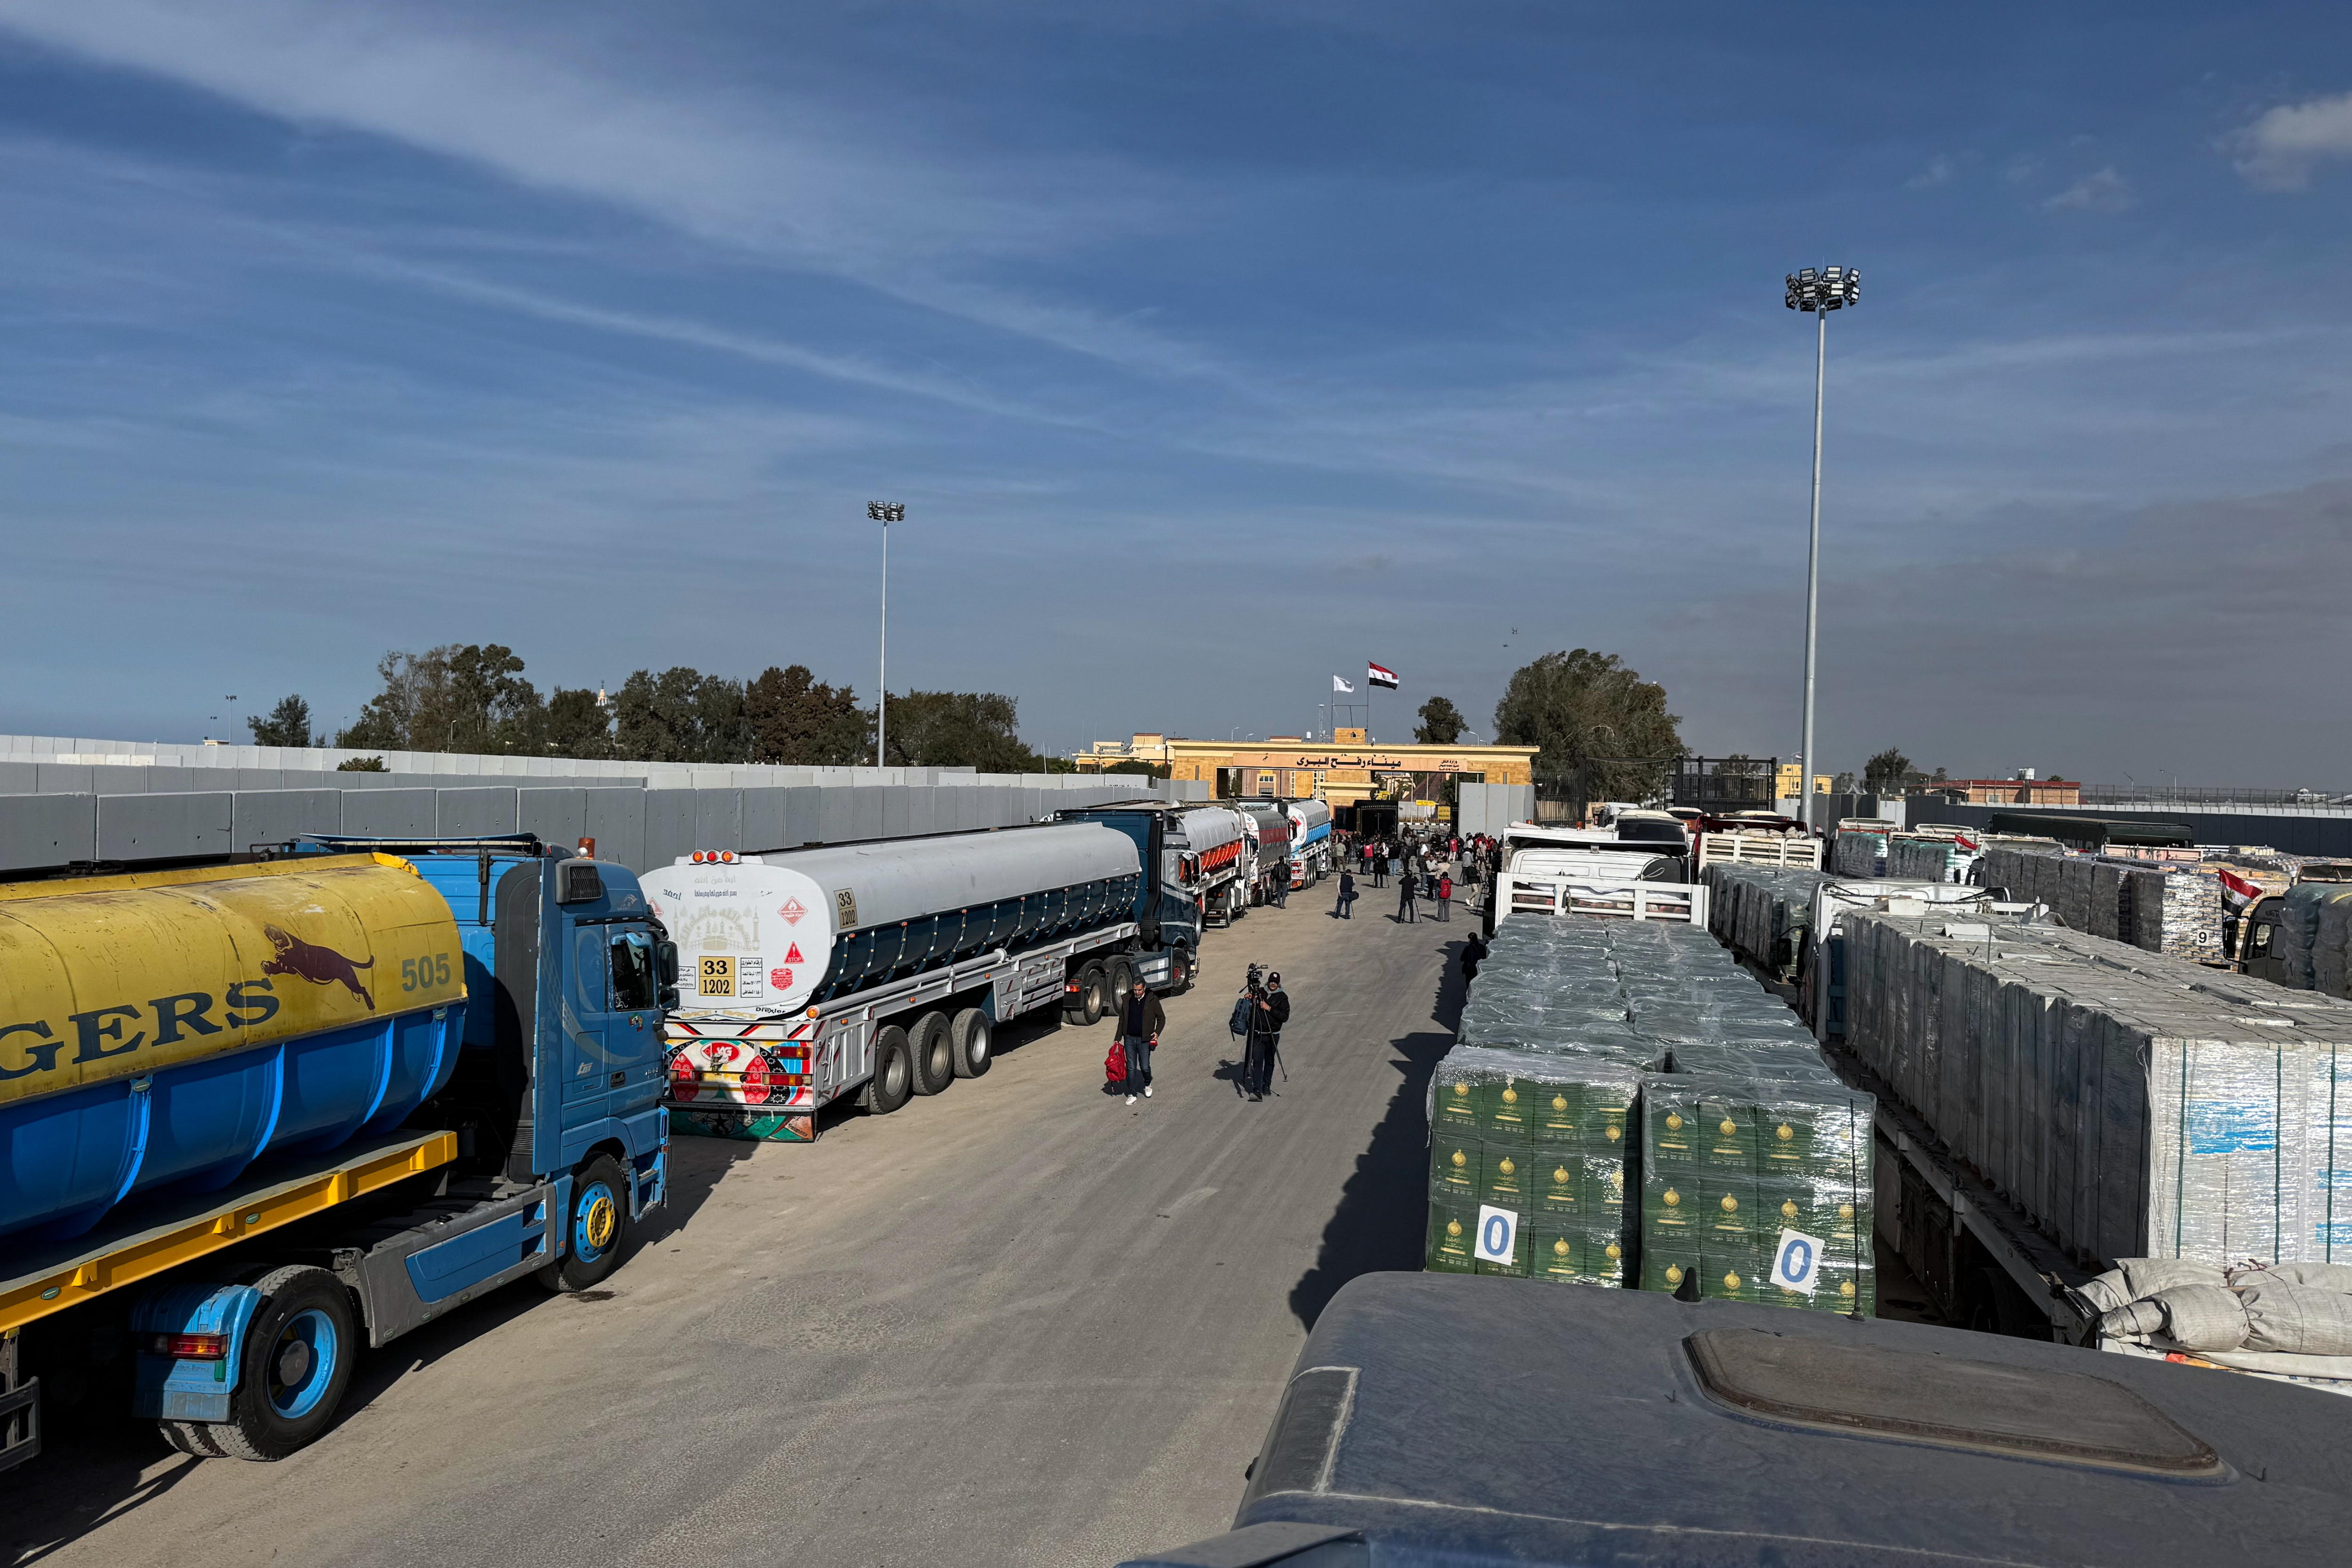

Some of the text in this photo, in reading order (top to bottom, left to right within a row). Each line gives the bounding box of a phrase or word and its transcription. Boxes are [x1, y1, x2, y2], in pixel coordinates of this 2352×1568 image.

[1331, 754, 1365, 768] رفح
[1367, 754, 1401, 769] ميناء
[838, 891, 852, 907] 33
[841, 909, 856, 926] 1202
[2198, 931, 2208, 944] 9
[402, 953, 451, 992] 505
[704, 960, 728, 975] 33
[703, 979, 730, 994] 1202
[0, 978, 279, 1080] GERS
[1484, 1215, 1510, 1256] 0
[1781, 1239, 1812, 1283] 0
